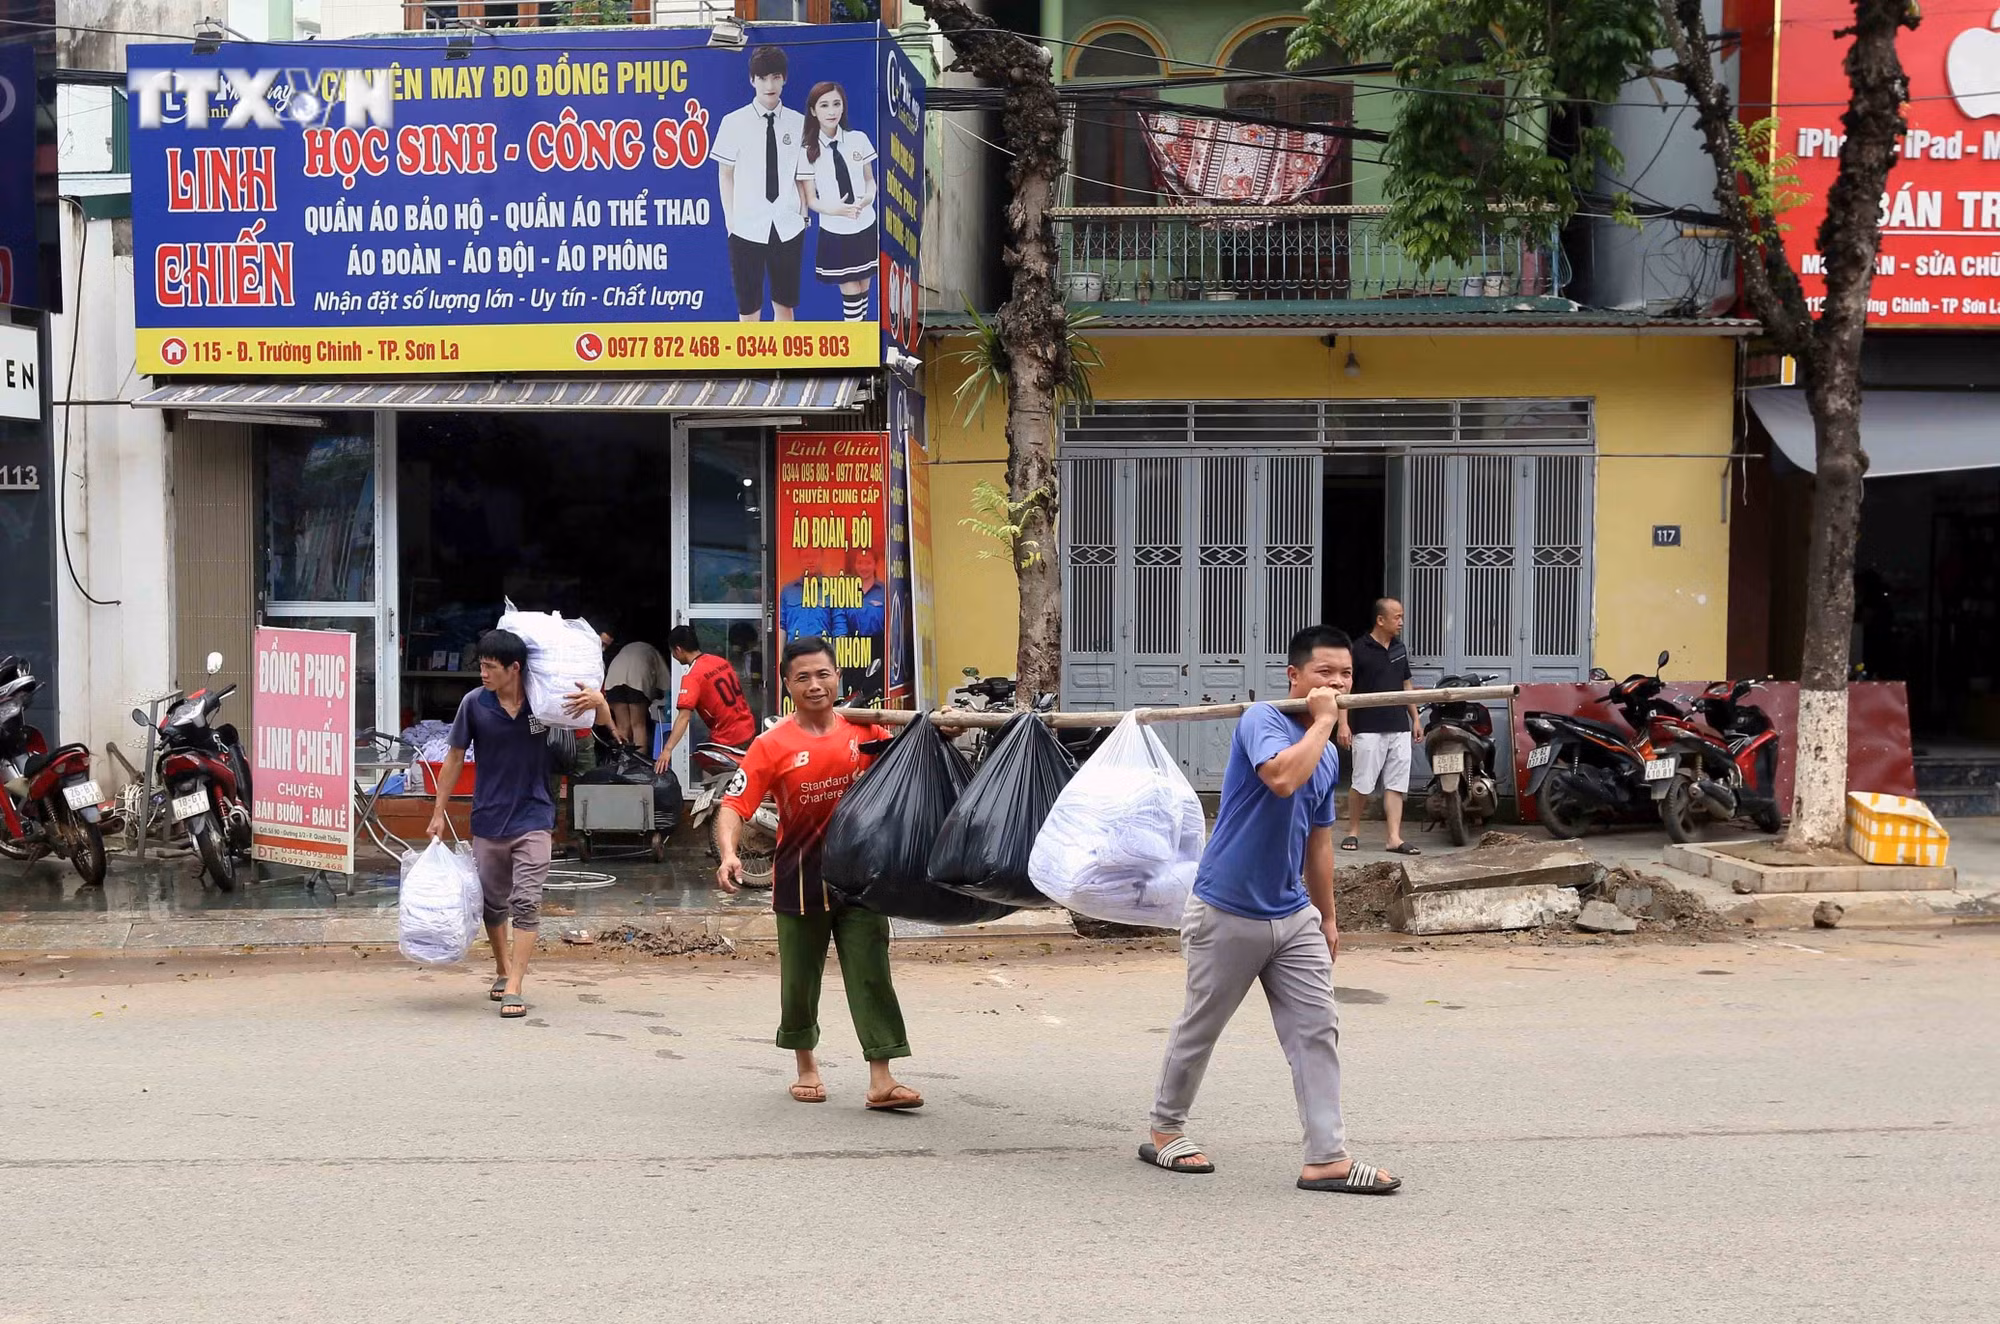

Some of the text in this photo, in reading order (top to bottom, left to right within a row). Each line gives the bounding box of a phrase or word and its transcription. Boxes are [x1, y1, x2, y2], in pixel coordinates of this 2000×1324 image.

[431, 66, 485, 99] MAY
[493, 65, 528, 97] ĐO
[536, 52, 608, 96] ĐỒNG
[617, 59, 687, 100] PHỤC
[303, 126, 389, 189] HỌC
[397, 123, 497, 174] SINH
[527, 106, 645, 172] CÔNG
[654, 98, 710, 169] SỞ
[1904, 130, 1963, 160] iPad
[166, 147, 277, 212] LINH
[305, 196, 363, 235] QUẦN
[370, 199, 398, 232] ÁO
[405, 195, 447, 232] BẢO
[455, 198, 483, 235] HỘ
[506, 192, 565, 232] QUẦN
[572, 195, 601, 227] ÁO
[608, 189, 648, 227] THỂ
[654, 198, 710, 226] THAO
[156, 218, 295, 307] CHIẾN
[347, 244, 375, 275] ÁO
[382, 242, 441, 275] ĐOÀN
[463, 240, 491, 273] ÁO
[498, 240, 534, 278] ĐỘI
[556, 239, 586, 272] ÁO
[592, 239, 668, 271] PHÔNG
[1915, 250, 1957, 276] SỬA
[314, 291, 362, 315] Nhận
[367, 291, 398, 314] đặt
[402, 287, 428, 310] số
[429, 288, 480, 313] lượng
[485, 287, 514, 308] lớn
[530, 288, 556, 312] Uy
[561, 287, 586, 307] tín
[602, 283, 646, 307] Chất
[651, 287, 703, 311] lượng
[1892, 296, 1930, 314] Chinh
[1941, 297, 1959, 314] TP
[1962, 297, 1987, 314] Sơn
[1989, 298, 2000, 314] L
[192, 341, 222, 362] 115
[237, 341, 253, 362] Đ.
[258, 340, 312, 365] Trường
[317, 340, 362, 362] Chinh
[378, 340, 400, 361] TP.
[405, 339, 436, 361] Sơn
[441, 340, 459, 361] La
[607, 336, 648, 358] 0977
[653, 336, 684, 358] 872
[689, 335, 720, 357] 468
[736, 335, 777, 357] 0344
[782, 335, 814, 357] 095
[819, 335, 849, 357] 803
[786, 440, 879, 456] Linh Chiến
[782, 463, 799, 482] 0344
[802, 463, 814, 482] 095
[816, 463, 829, 482] 803
[836, 463, 853, 482] 0977
[855, 463, 868, 482] 872
[792, 485, 830, 504] CHUYÊN
[832, 489, 858, 504] CUNG
[861, 484, 880, 504] CẤP
[792, 510, 809, 548] ÁO
[812, 510, 848, 552] ĐOÀN,
[852, 510, 872, 555] ĐỘI
[1657, 529, 1676, 542] 117
[802, 570, 863, 608] ÁO PHÔNG
[836, 630, 871, 668] NHÓM
[259, 636, 345, 708] ĐỒNG PHỤC
[258, 718, 342, 776] LINH CHIẾN
[277, 782, 323, 799] CHUYÊN
[799, 789, 844, 805] Chartere
[800, 774, 849, 792] Standard
[255, 797, 274, 820] BÁN
[276, 800, 303, 823] BUÔN
[312, 804, 332, 827] BÁN
